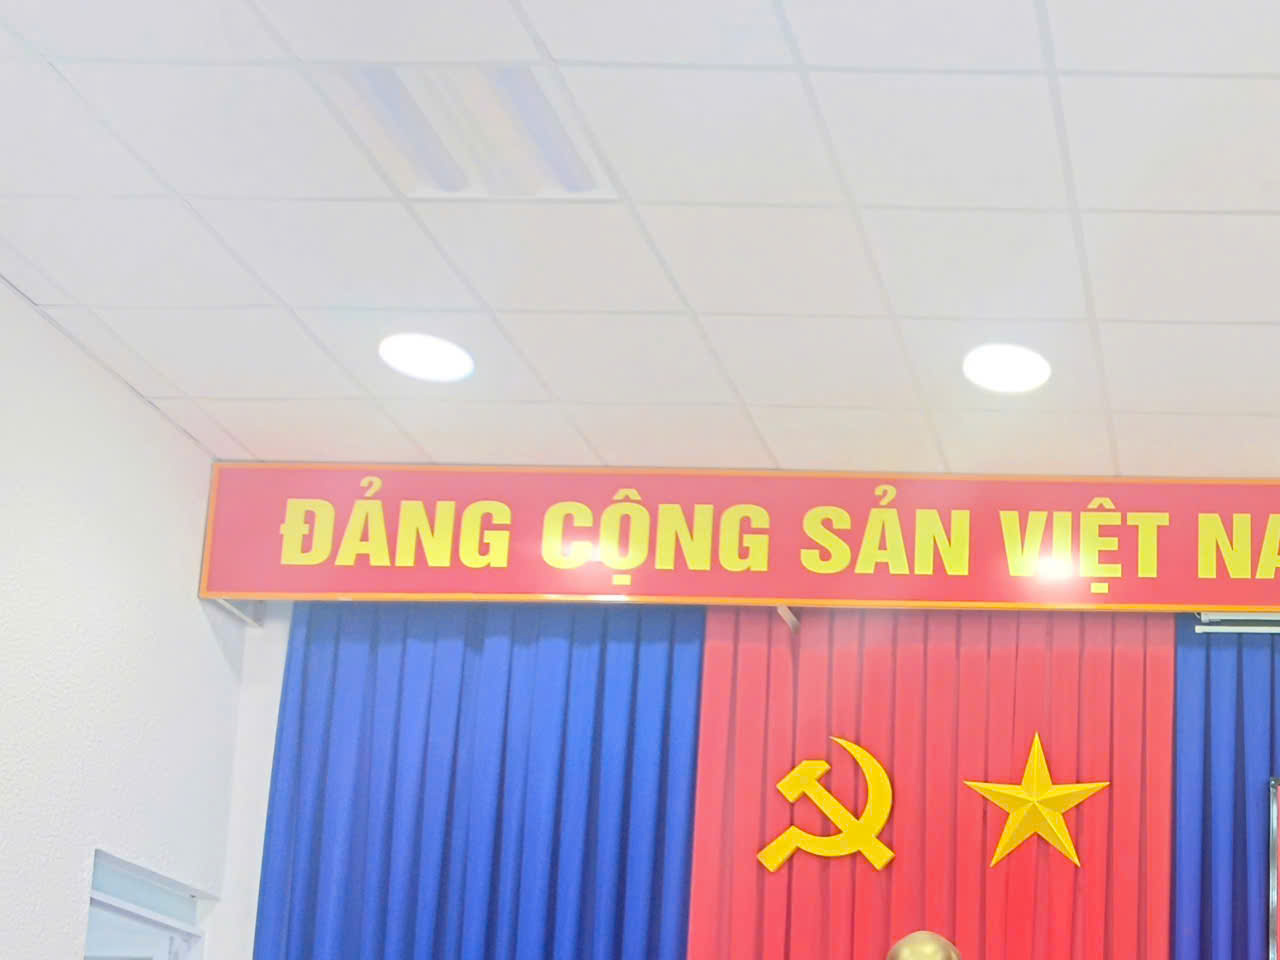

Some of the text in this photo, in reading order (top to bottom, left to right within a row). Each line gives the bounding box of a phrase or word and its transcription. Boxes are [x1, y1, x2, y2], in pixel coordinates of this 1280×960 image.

[280, 475, 512, 568] ĐẢNG
[541, 488, 770, 586] CỘNG
[800, 485, 969, 576] SẢN
[1001, 497, 1170, 593] VIỆT
